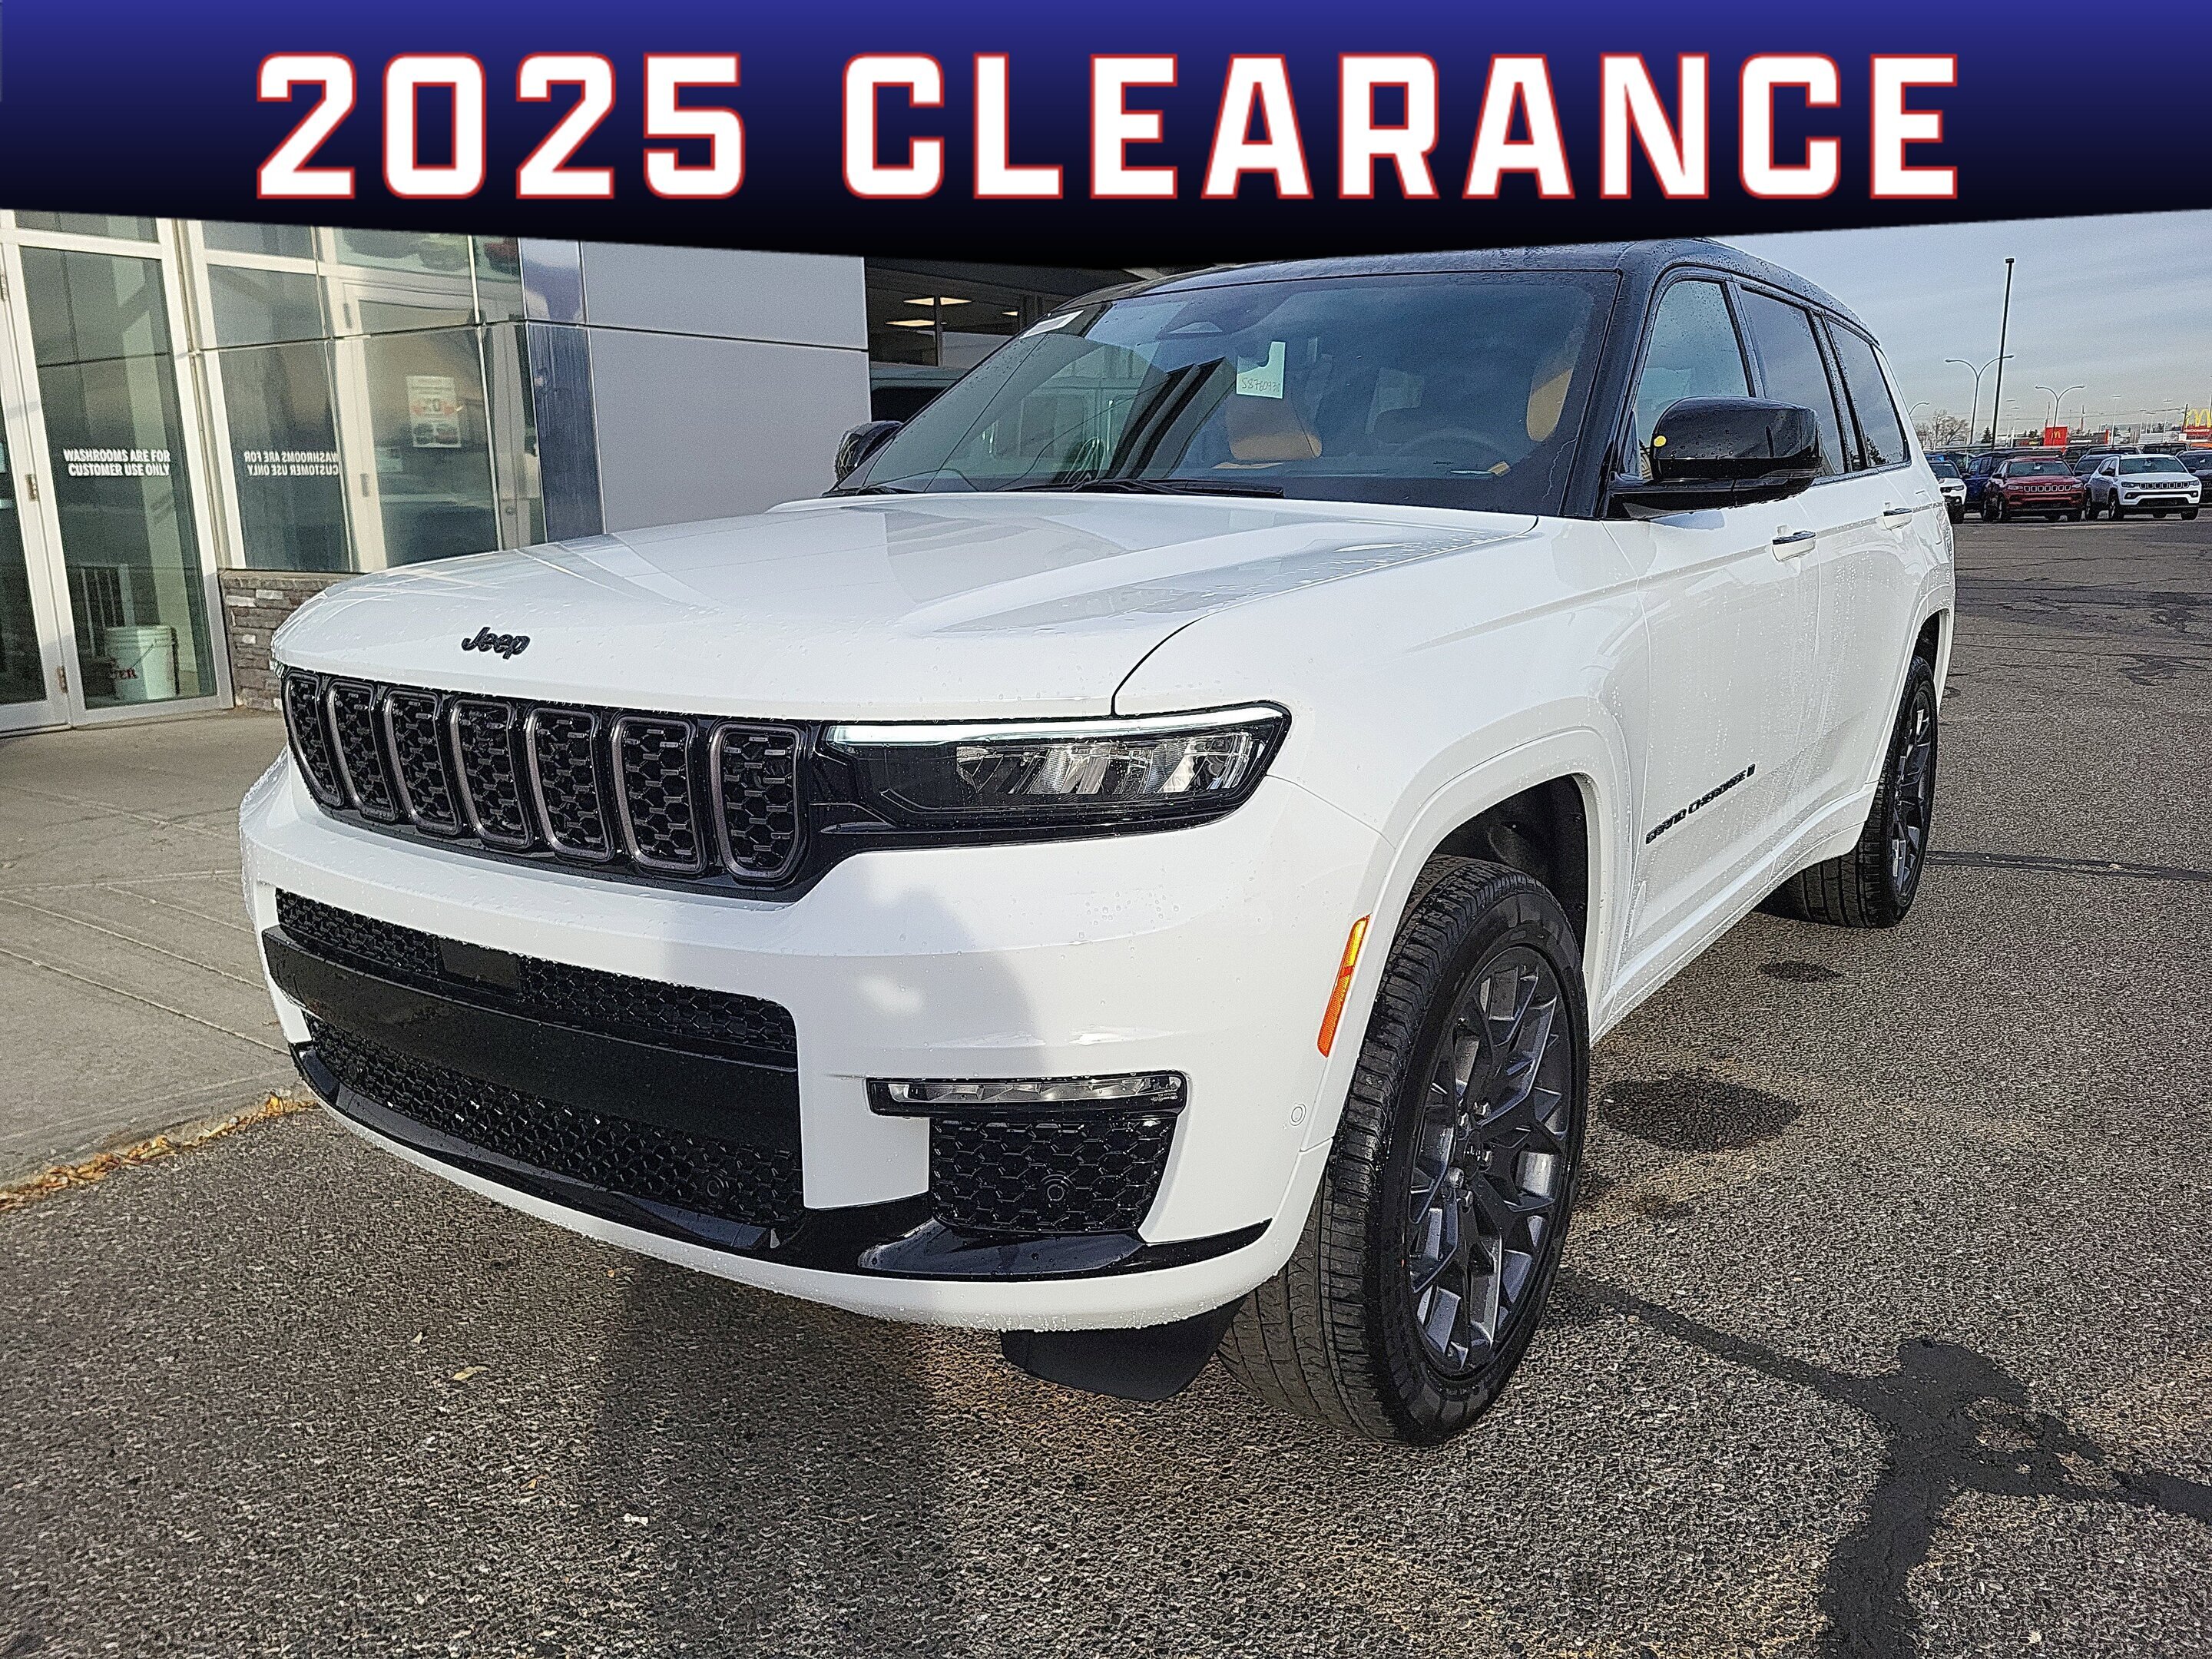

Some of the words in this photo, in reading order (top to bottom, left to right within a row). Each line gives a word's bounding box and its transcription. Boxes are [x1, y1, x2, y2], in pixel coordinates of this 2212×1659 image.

[63, 448, 129, 462] WASHROOMS
[130, 449, 151, 462] ARE
[151, 449, 171, 462] FOR
[68, 462, 124, 477] CUSTOMER
[124, 462, 144, 476] USE
[144, 462, 171, 476] ONLY
[461, 626, 531, 661] Jeep
[1645, 807, 1687, 845] GRAND
[1687, 769, 1747, 815] CHEROKEE
